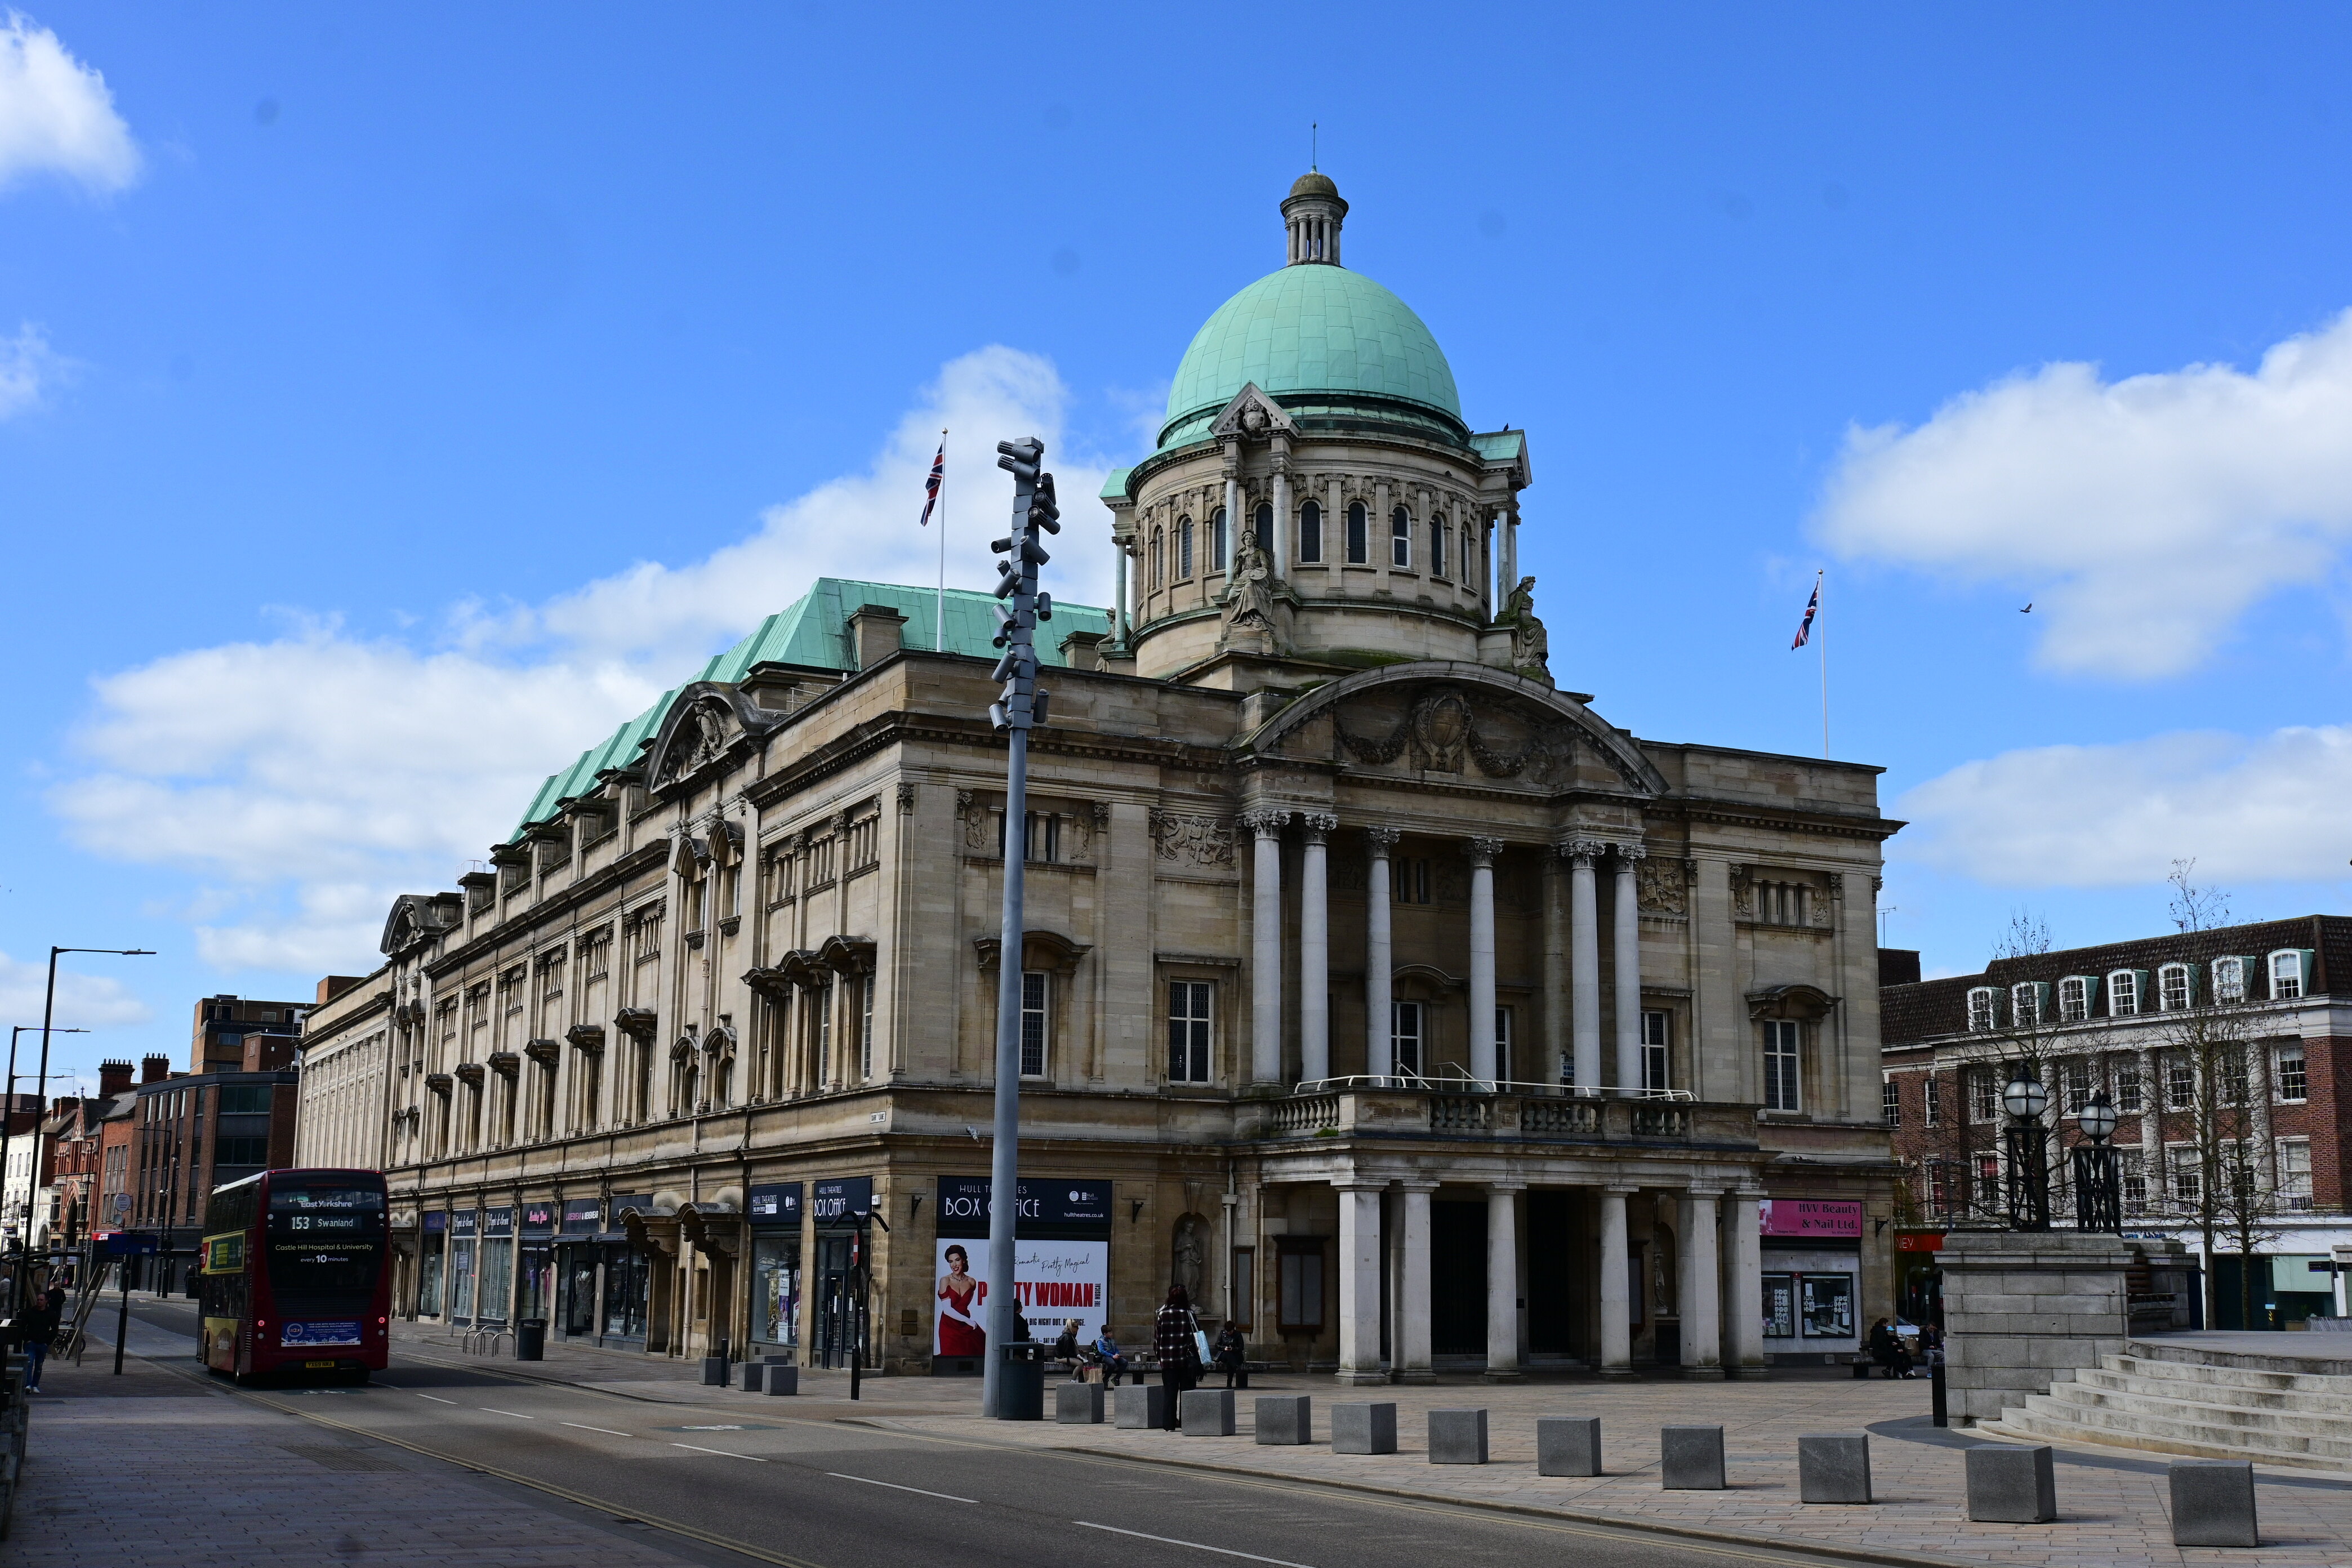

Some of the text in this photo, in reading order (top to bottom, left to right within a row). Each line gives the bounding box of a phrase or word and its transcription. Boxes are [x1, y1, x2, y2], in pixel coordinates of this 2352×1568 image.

[752, 1196, 761, 1204] HULL
[814, 1199, 826, 1217] BOX
[827, 1198, 846, 1216] OFFICE
[946, 1197, 1040, 1217] BOX ICE
[1823, 1204, 1857, 1217] Beauty
[291, 1217, 354, 1230] 153 Swanland
[1802, 1219, 1857, 1229] & Nail Ltd.
[315, 1254, 327, 1263] 10
[1014, 1253, 1090, 1277] Romantic Pretty Magical
[978, 1281, 1093, 1307] PTY WOMAN
